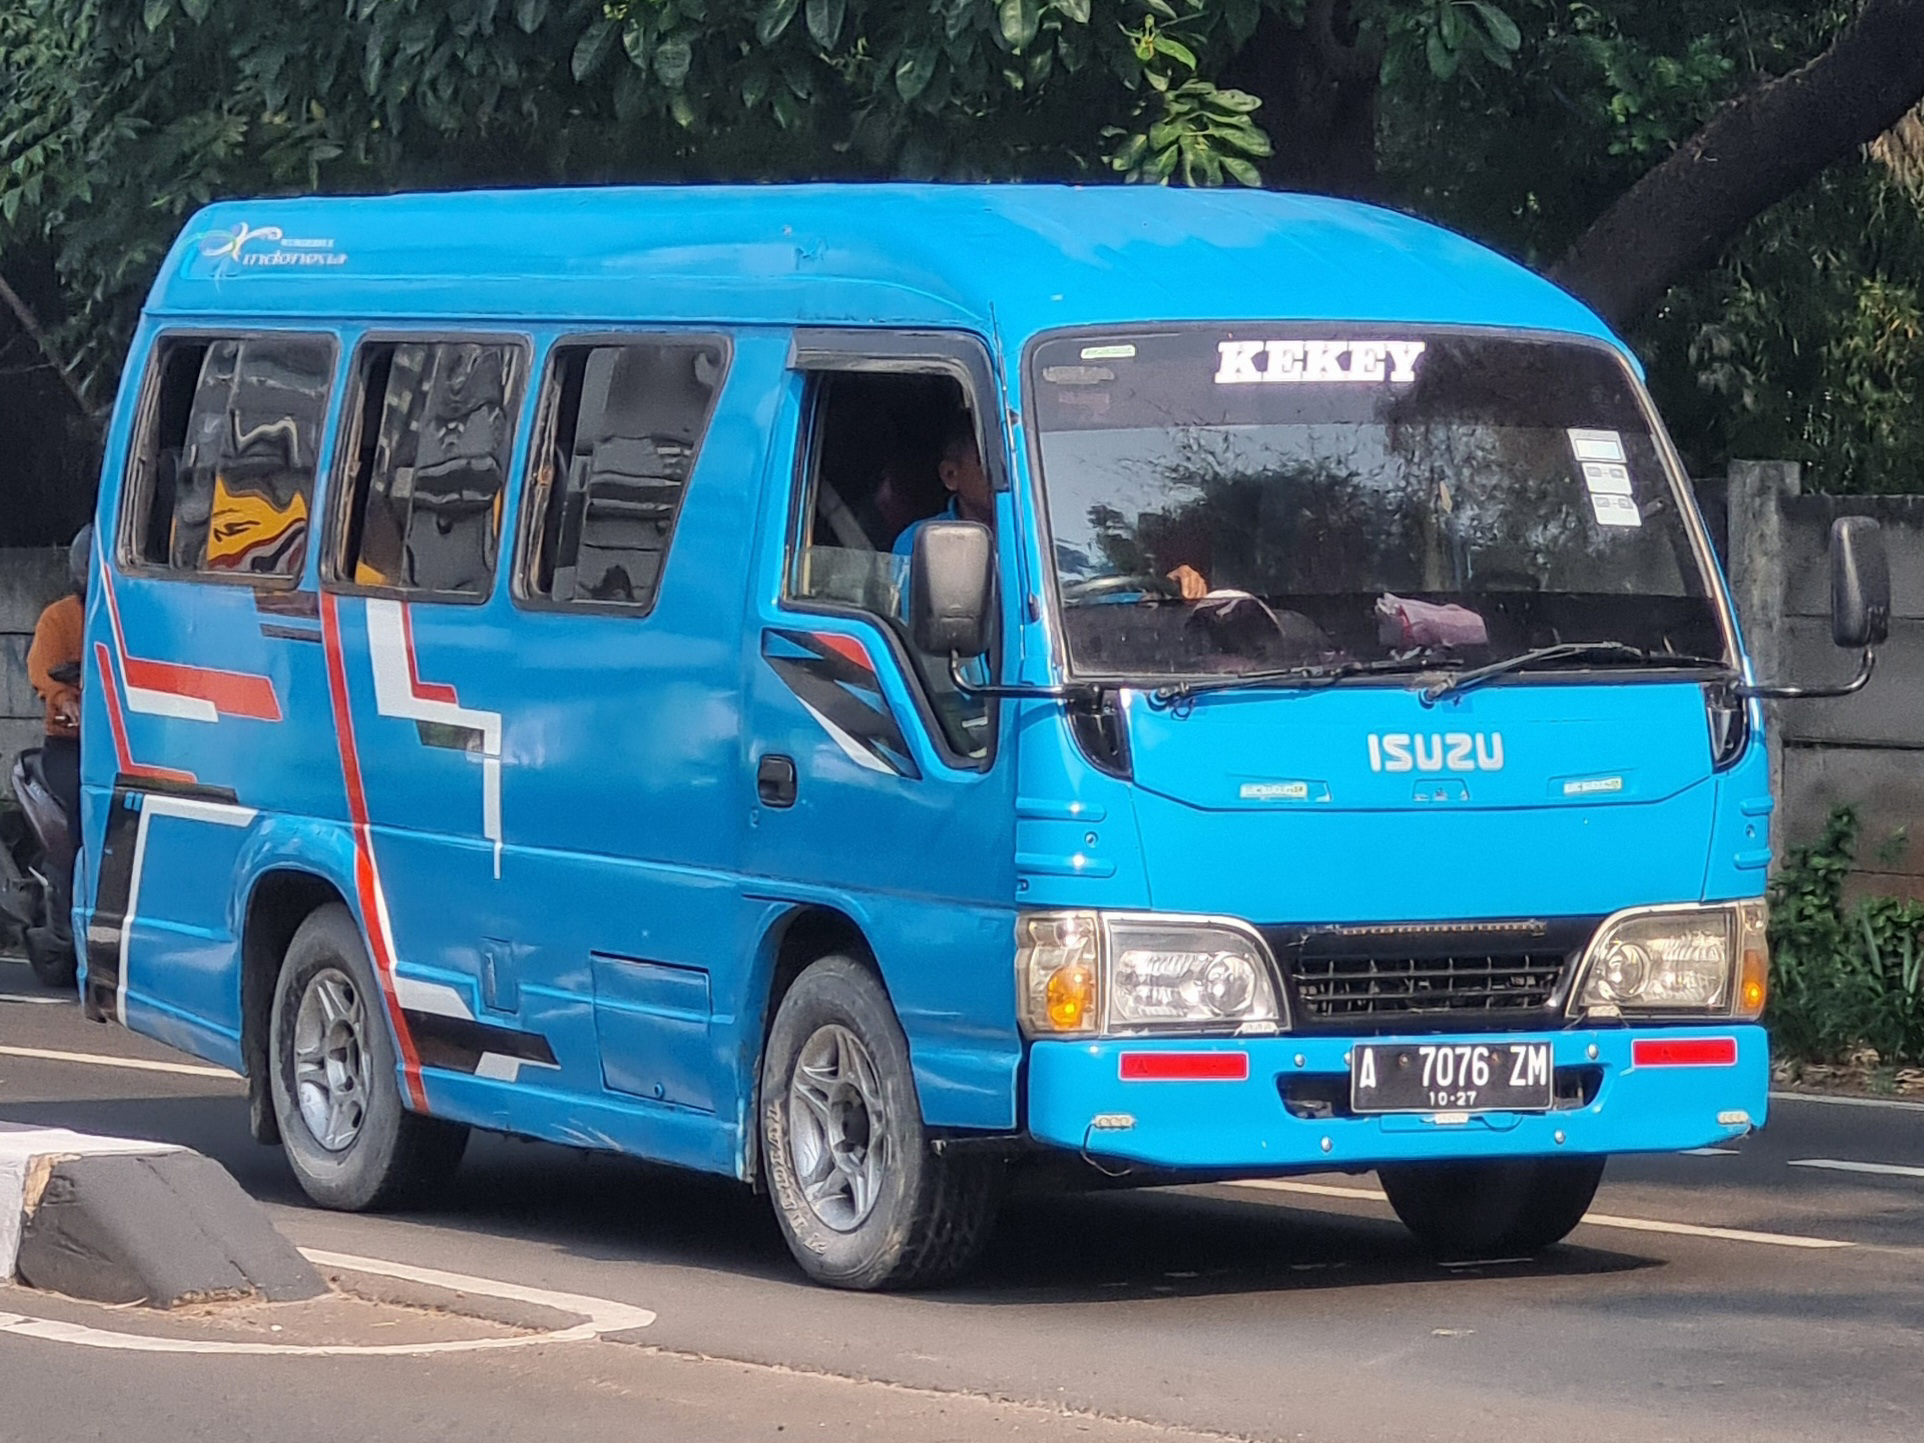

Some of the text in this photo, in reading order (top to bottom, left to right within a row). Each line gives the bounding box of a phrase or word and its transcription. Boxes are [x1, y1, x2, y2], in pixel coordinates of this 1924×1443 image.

[1214, 340, 1425, 383] KEKEY
[1367, 732, 1504, 772] ISUZU
[1359, 1045, 1547, 1088] A 7076 ZM
